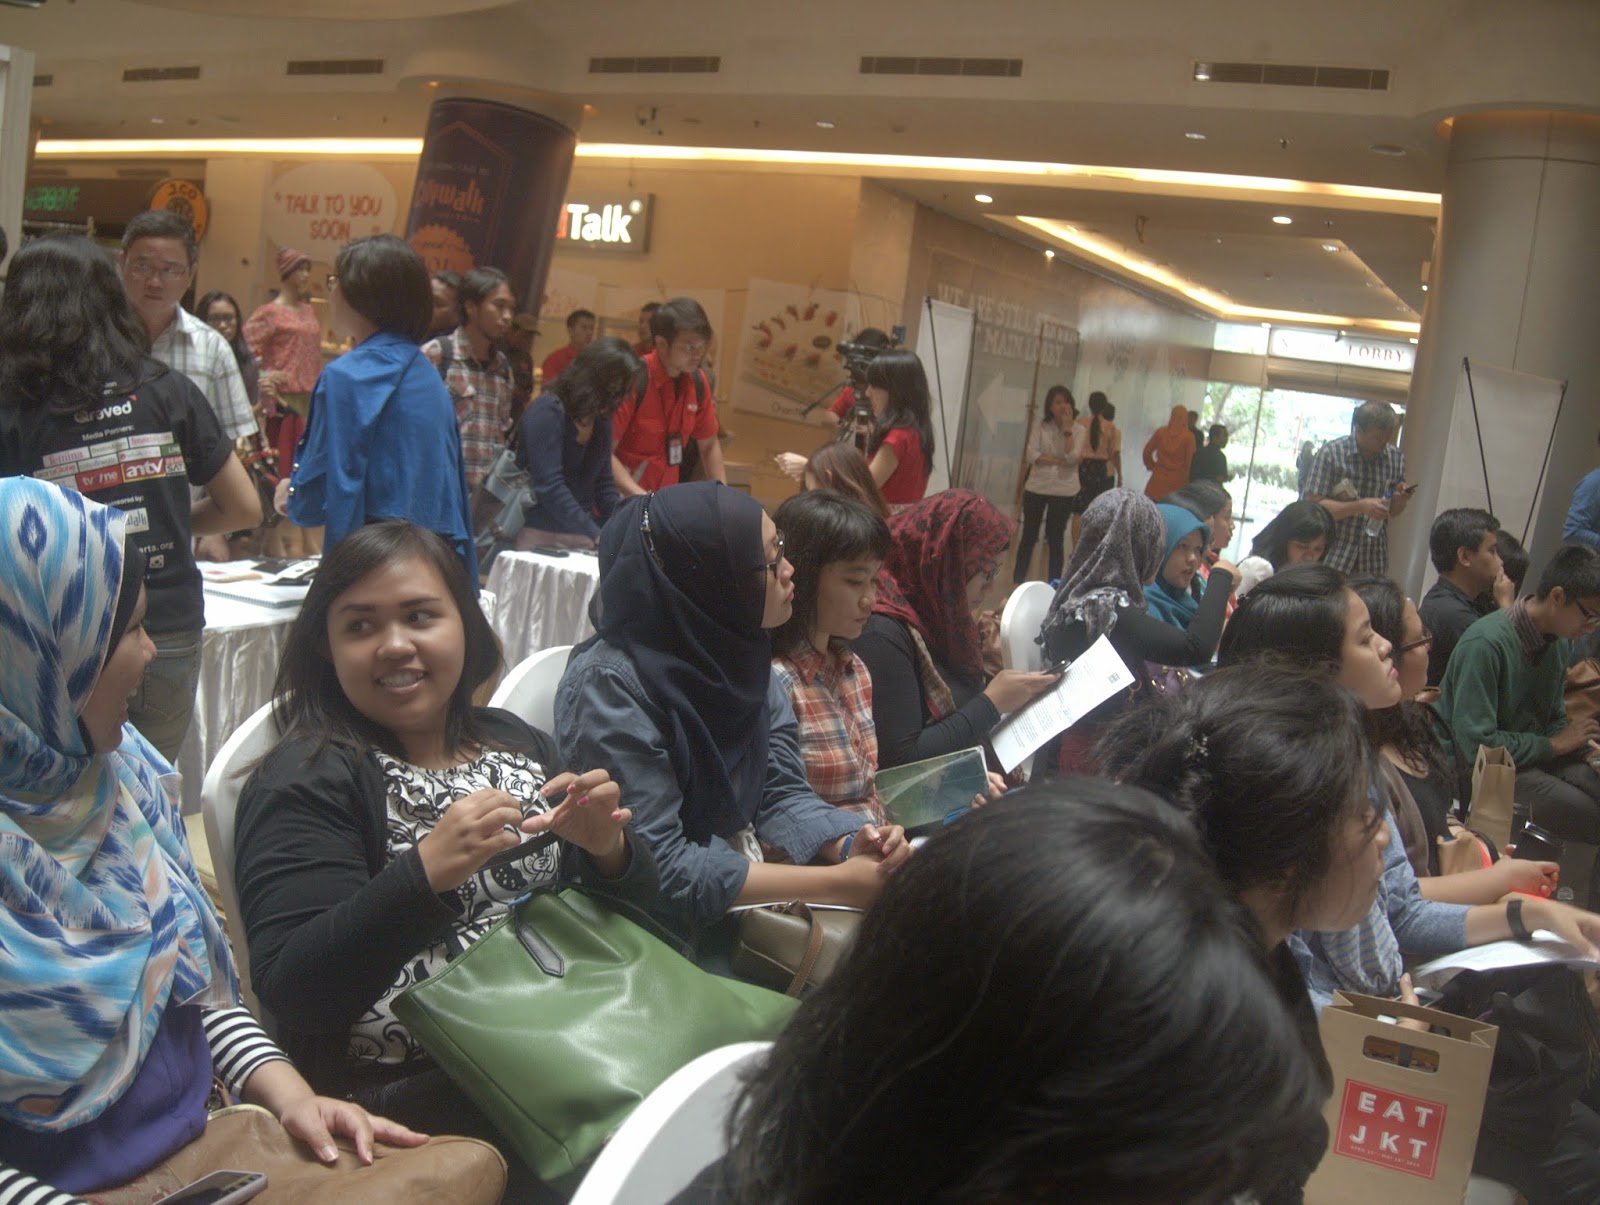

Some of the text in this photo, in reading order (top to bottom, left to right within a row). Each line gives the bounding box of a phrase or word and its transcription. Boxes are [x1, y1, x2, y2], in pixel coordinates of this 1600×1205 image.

[325, 194, 345, 215] TO
[348, 194, 383, 216] YOU
[309, 219, 350, 240] SOON
[1358, 1091, 1433, 1128] EAT
[1349, 1125, 1427, 1160] JKT
